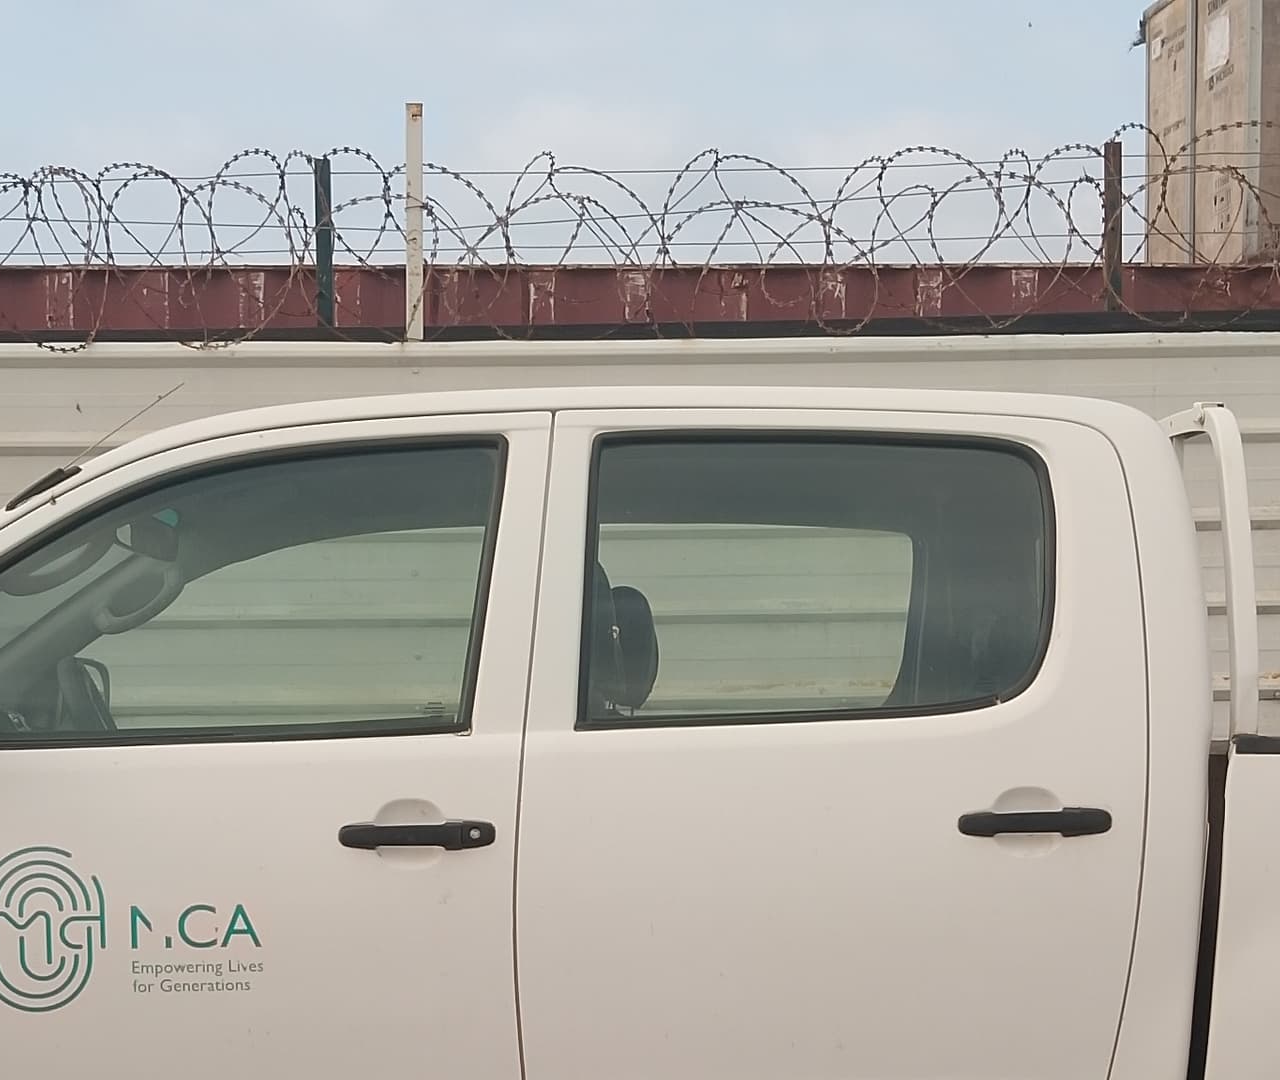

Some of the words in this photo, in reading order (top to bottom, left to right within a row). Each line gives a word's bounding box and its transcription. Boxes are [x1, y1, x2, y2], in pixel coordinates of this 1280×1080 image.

[131, 960, 224, 978] Empowering
[228, 960, 264, 973] Lives
[133, 979, 155, 993] for
[160, 978, 252, 993] Generations
